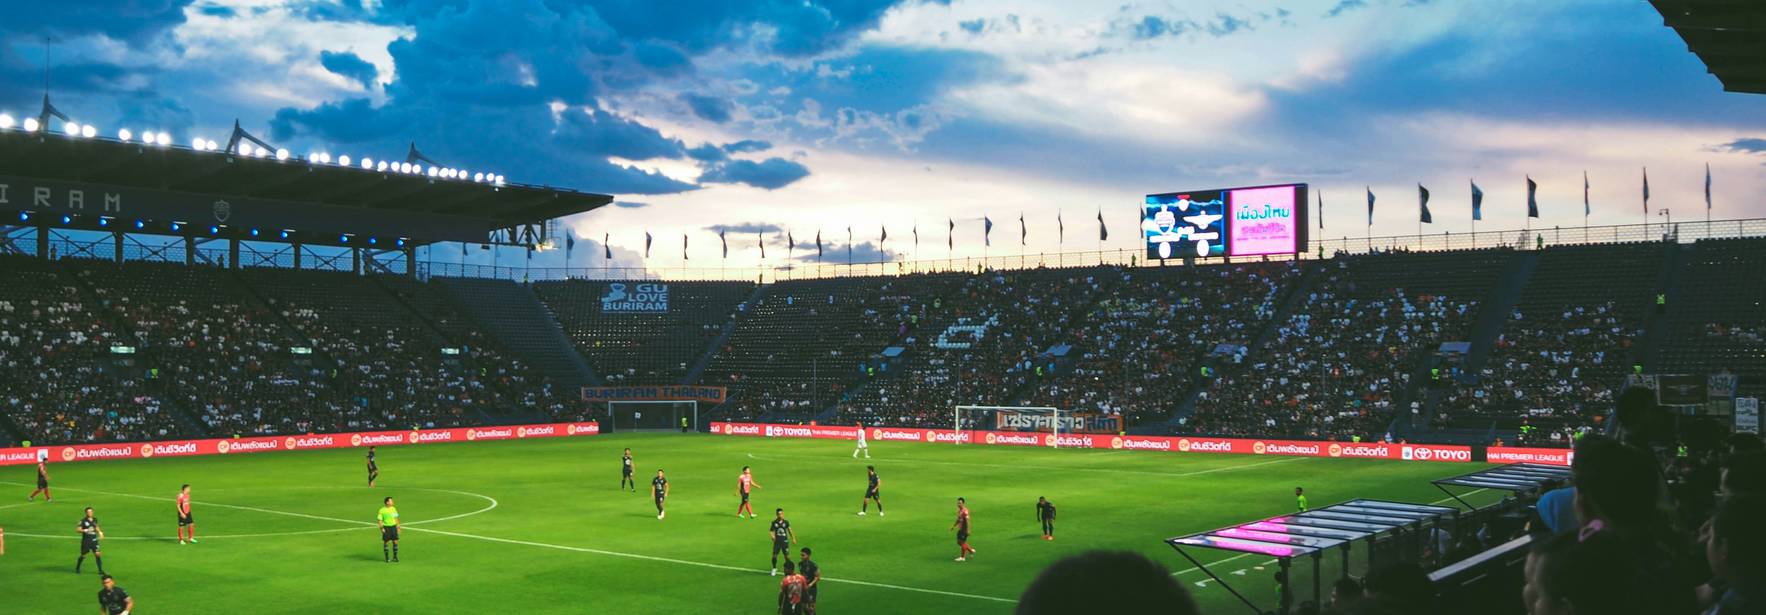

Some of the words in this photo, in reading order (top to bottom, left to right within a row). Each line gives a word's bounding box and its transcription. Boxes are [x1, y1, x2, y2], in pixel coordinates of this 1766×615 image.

[636, 283, 668, 293] GU
[628, 293, 668, 302] LOVE
[603, 302, 668, 311] BURIRAM
[585, 387, 658, 399] BURIRAM
[783, 428, 812, 437] TOYOTA
[7, 452, 35, 461] LEAGUE
[1500, 453, 1534, 461] PREMIER
[1535, 454, 1565, 462] LEAGUE
